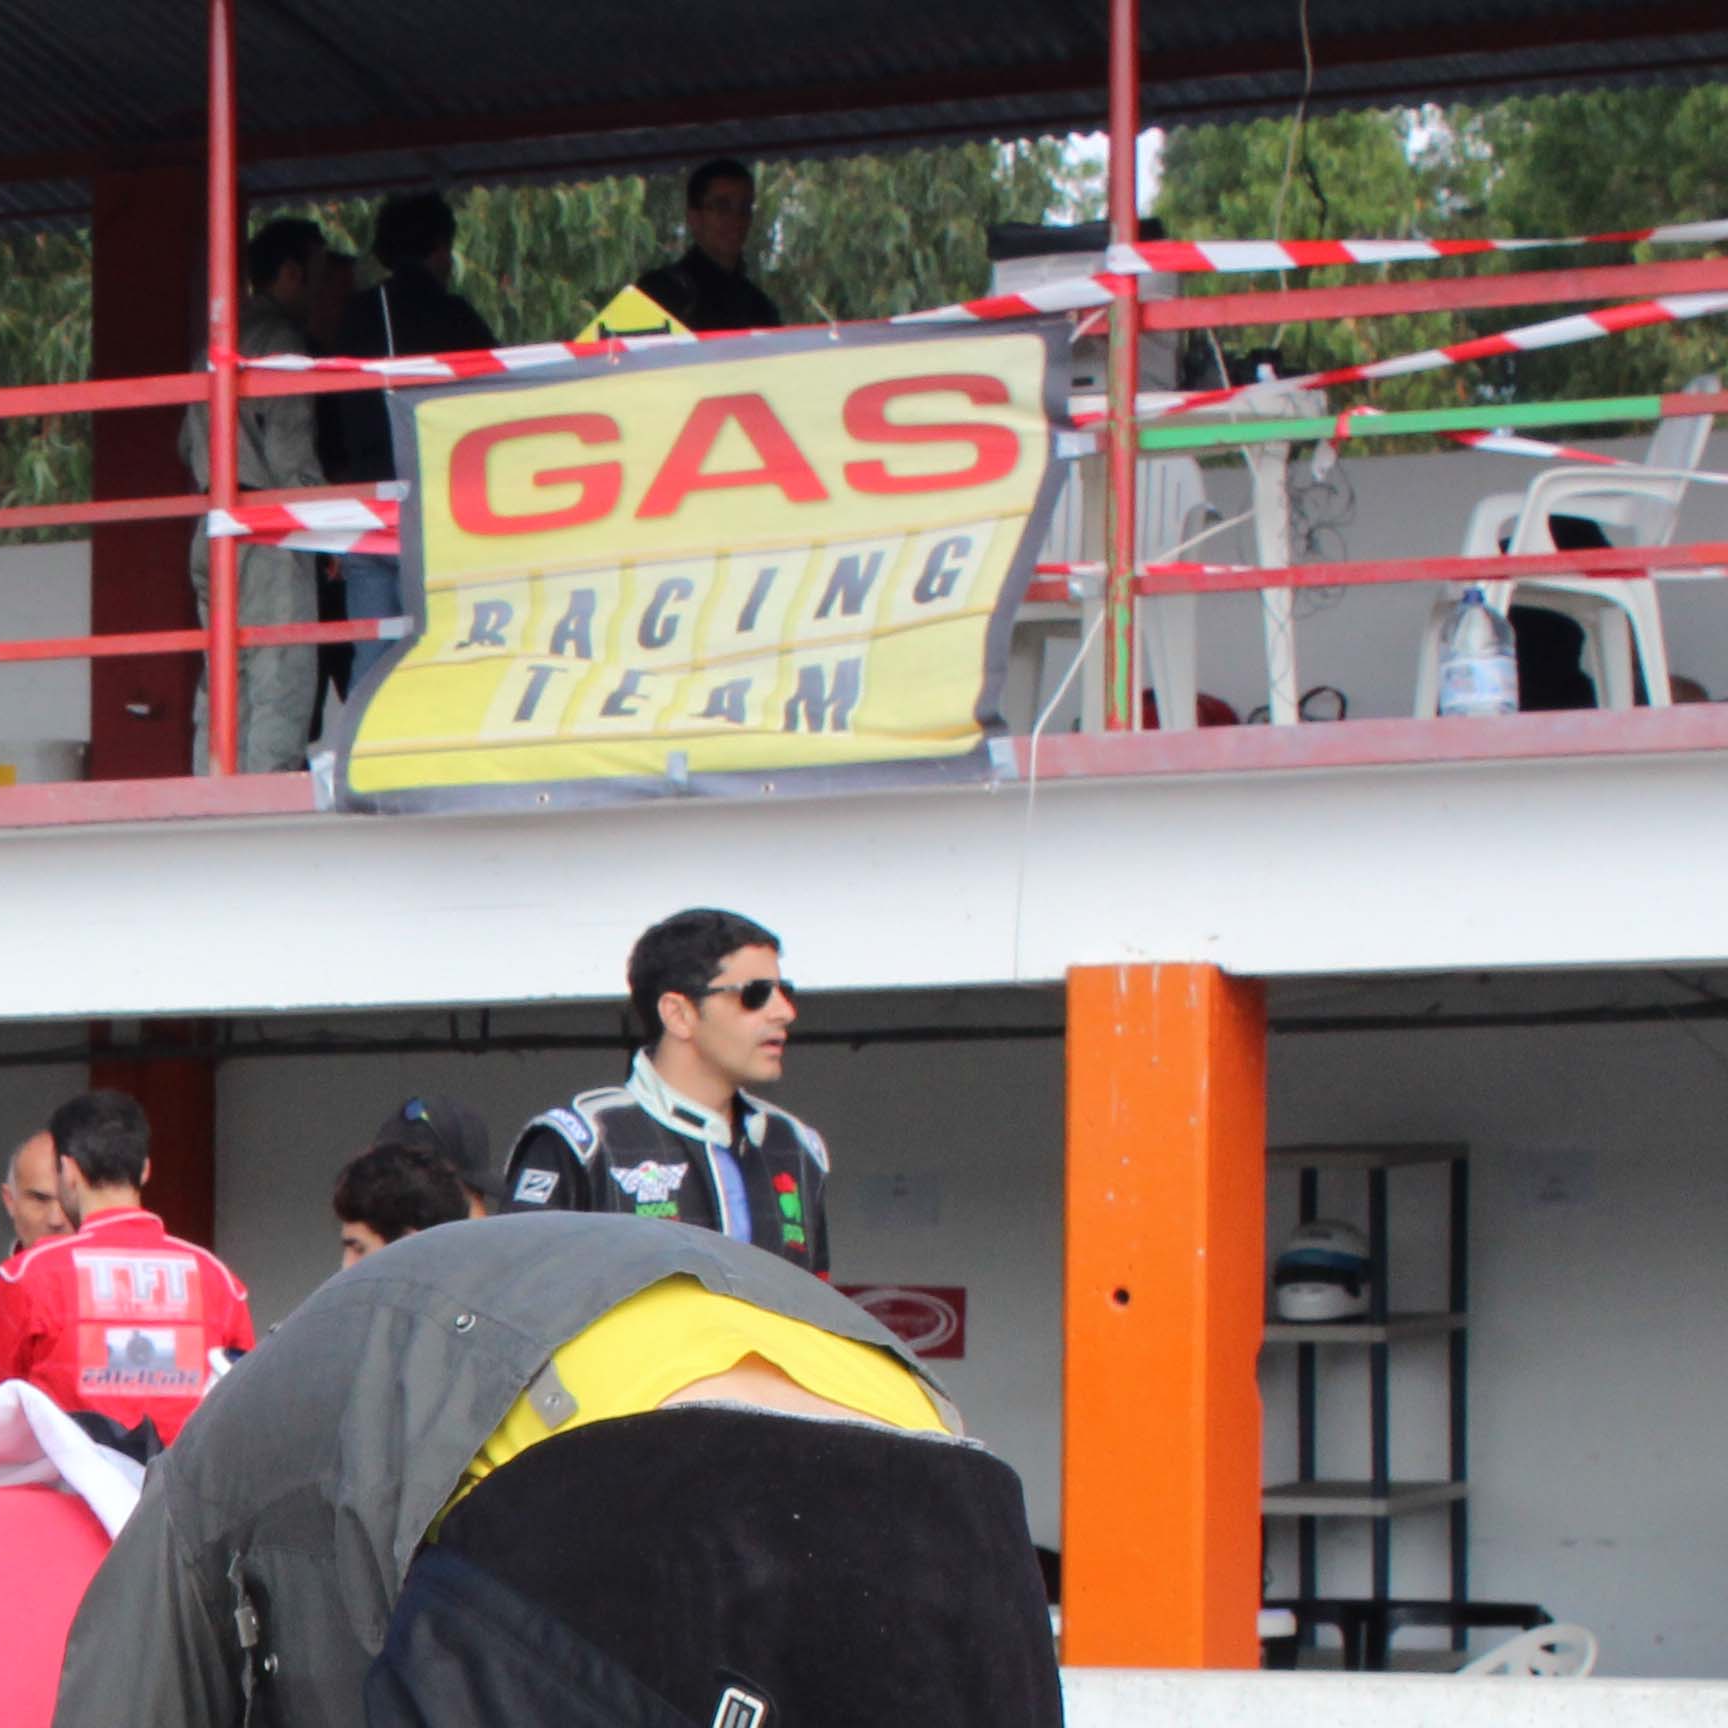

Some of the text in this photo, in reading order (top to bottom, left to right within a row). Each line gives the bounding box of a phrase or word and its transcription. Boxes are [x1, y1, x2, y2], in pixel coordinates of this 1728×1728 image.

[449, 373, 1021, 537] GAS
[456, 535, 972, 660] RACING
[511, 655, 861, 734] TEAM
